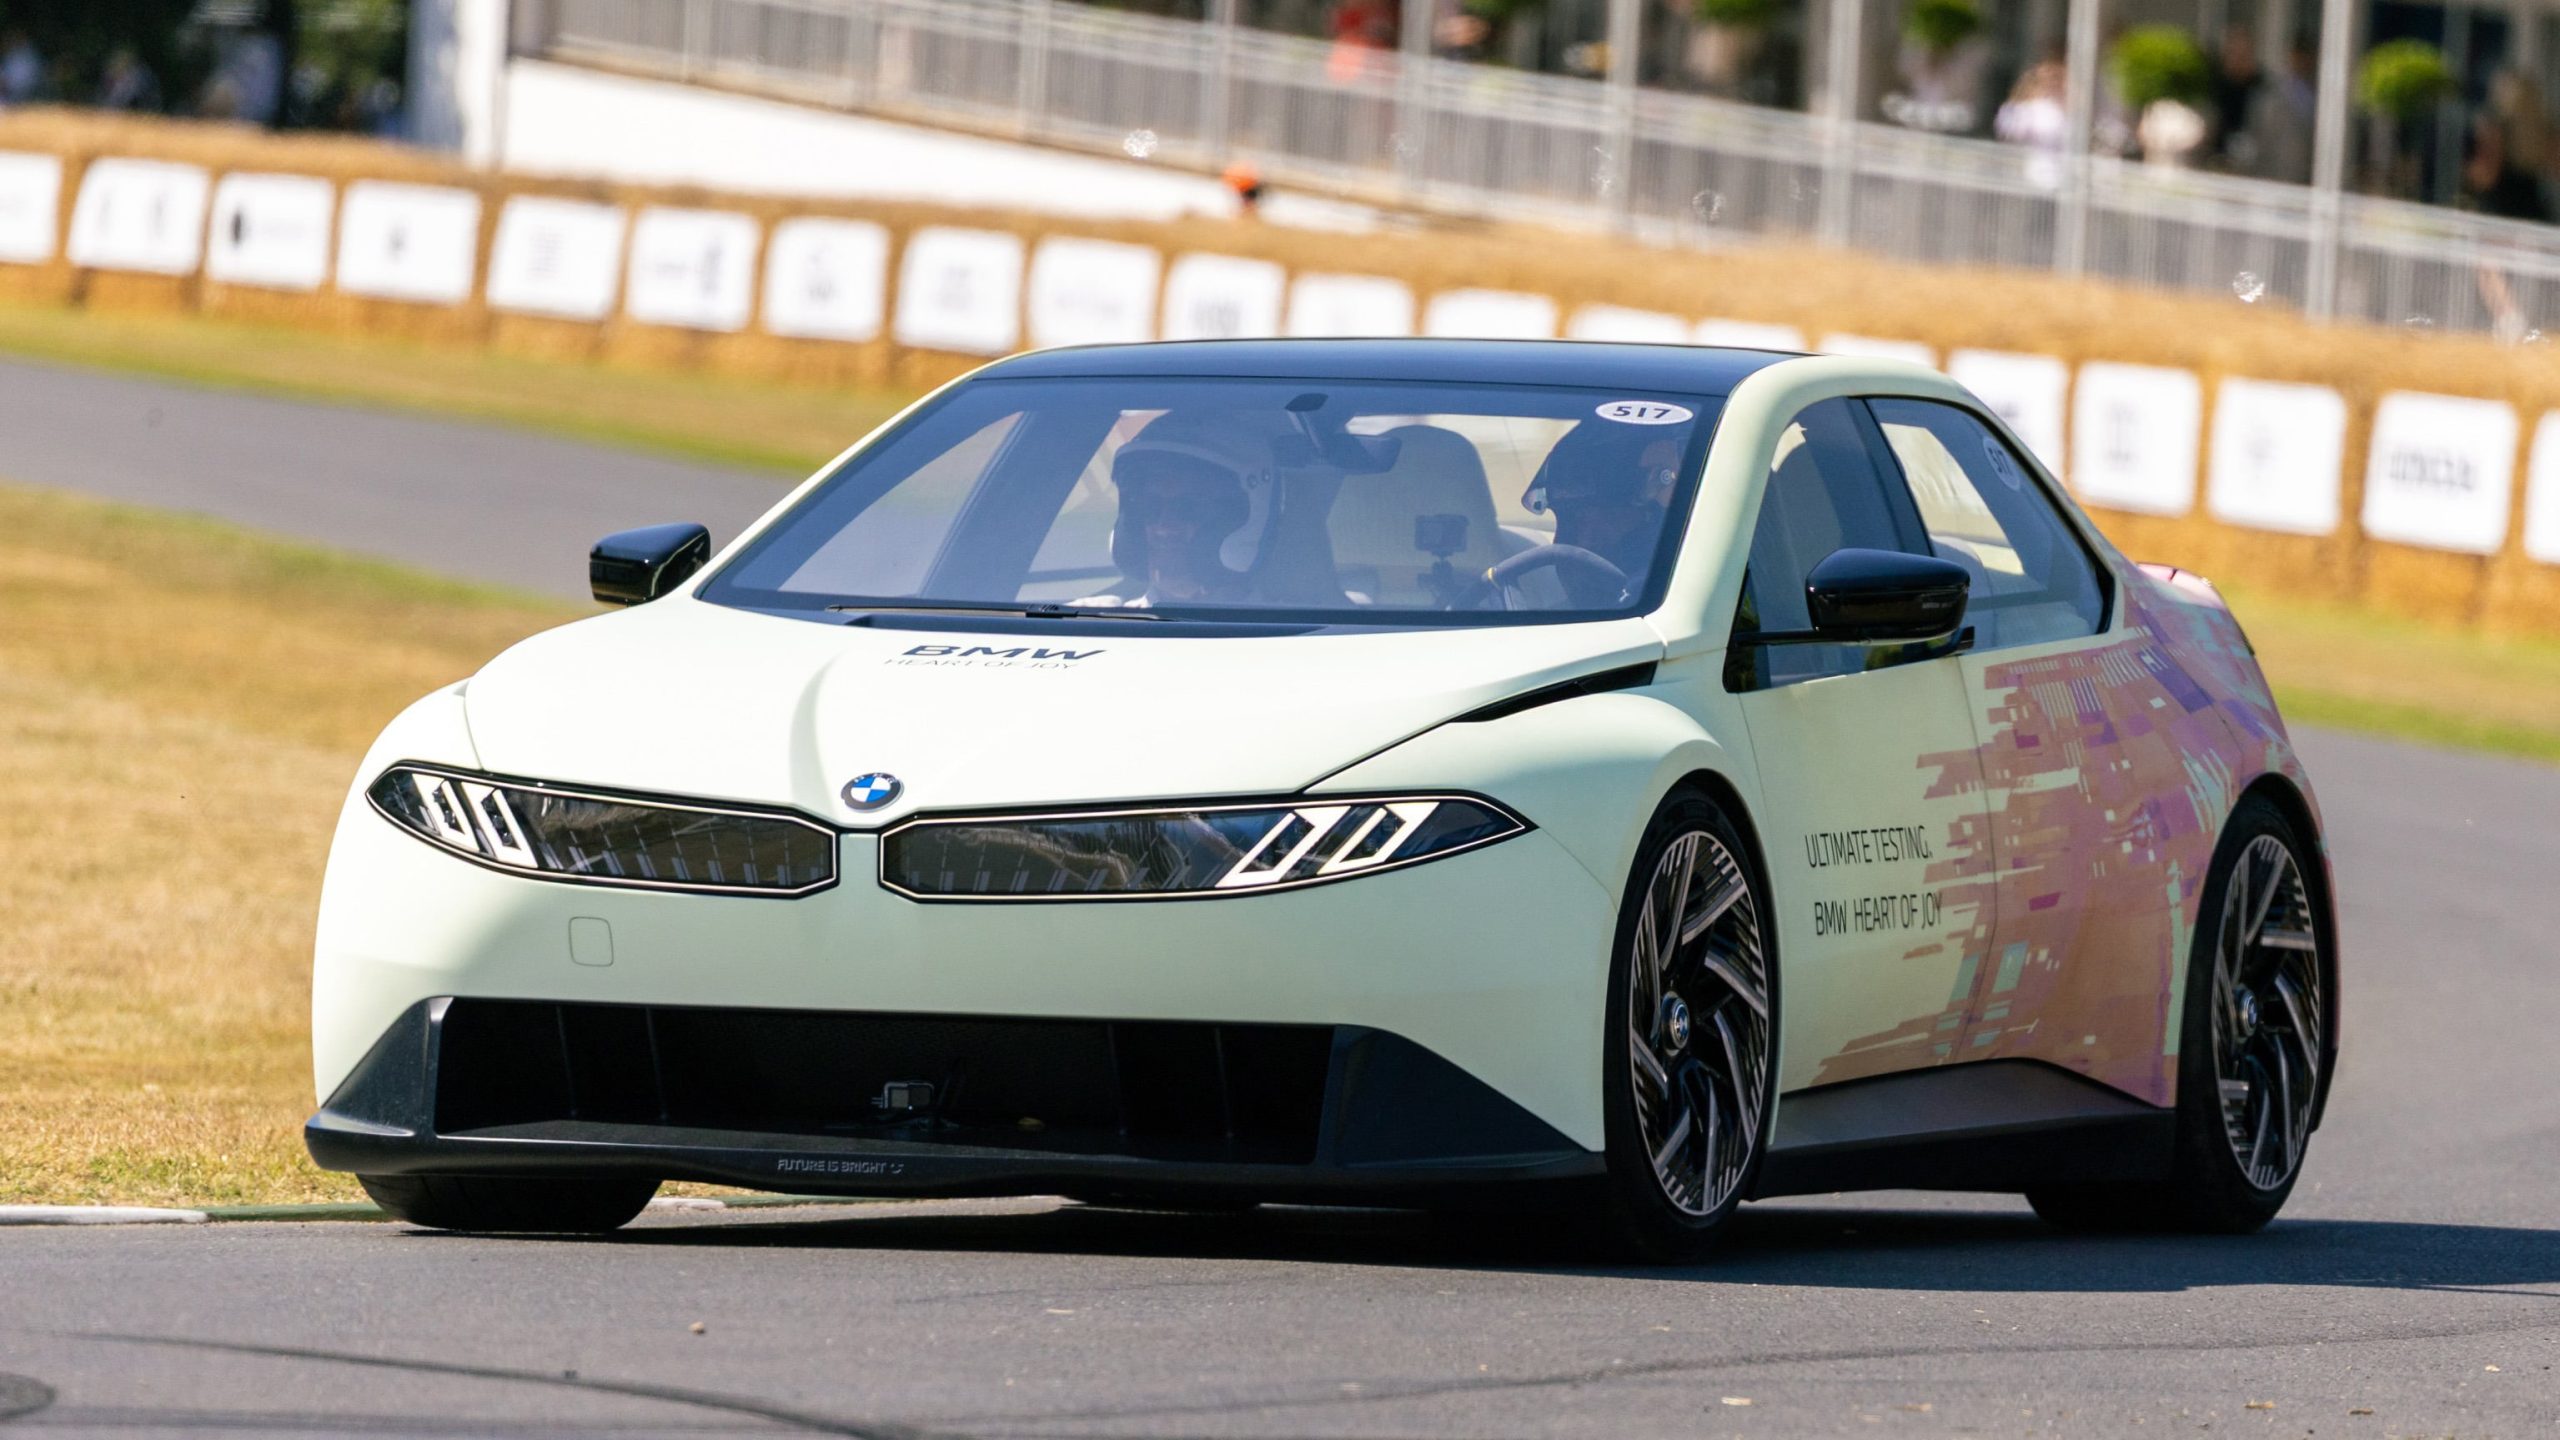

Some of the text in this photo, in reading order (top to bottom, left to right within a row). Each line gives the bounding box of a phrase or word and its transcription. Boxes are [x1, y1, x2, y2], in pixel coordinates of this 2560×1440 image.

[1613, 406, 1671, 419] 517
[902, 645, 1105, 660] BMW
[884, 658, 1079, 670] HEART OF JOY
[1805, 825, 1933, 868] ULTIMATE TESTING.
[1814, 891, 1943, 936] BMW HEART OF JOY
[777, 1159, 886, 1174] FUTURE IS BRIGHT
